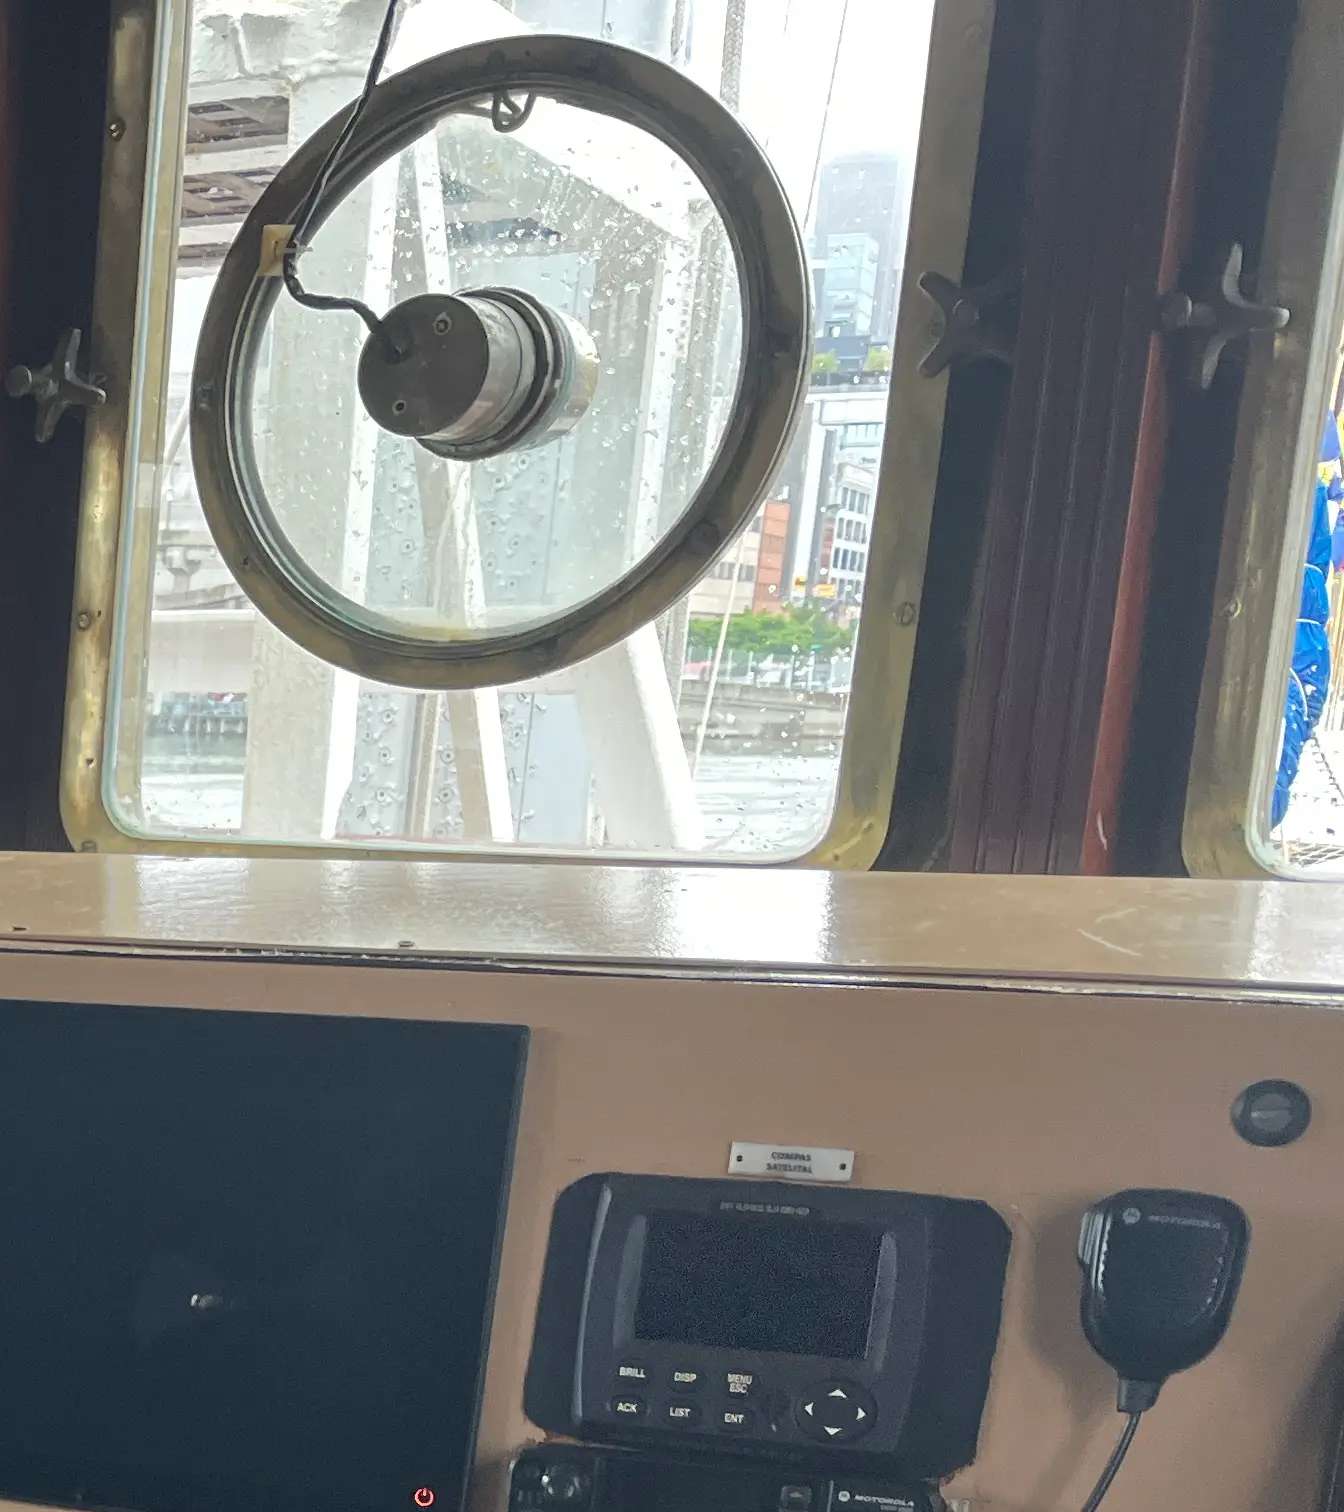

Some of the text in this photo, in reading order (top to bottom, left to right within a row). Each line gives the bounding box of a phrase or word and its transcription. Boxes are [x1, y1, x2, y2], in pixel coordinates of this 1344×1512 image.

[771, 1151, 812, 1162] COMPAS
[619, 1366, 646, 1378] BRILL
[673, 1371, 697, 1383] DISP
[727, 1373, 753, 1385] MENU
[729, 1383, 748, 1393] ESC
[616, 1402, 638, 1413] ACK
[669, 1406, 691, 1418] LIST
[724, 1412, 745, 1424] ENT
